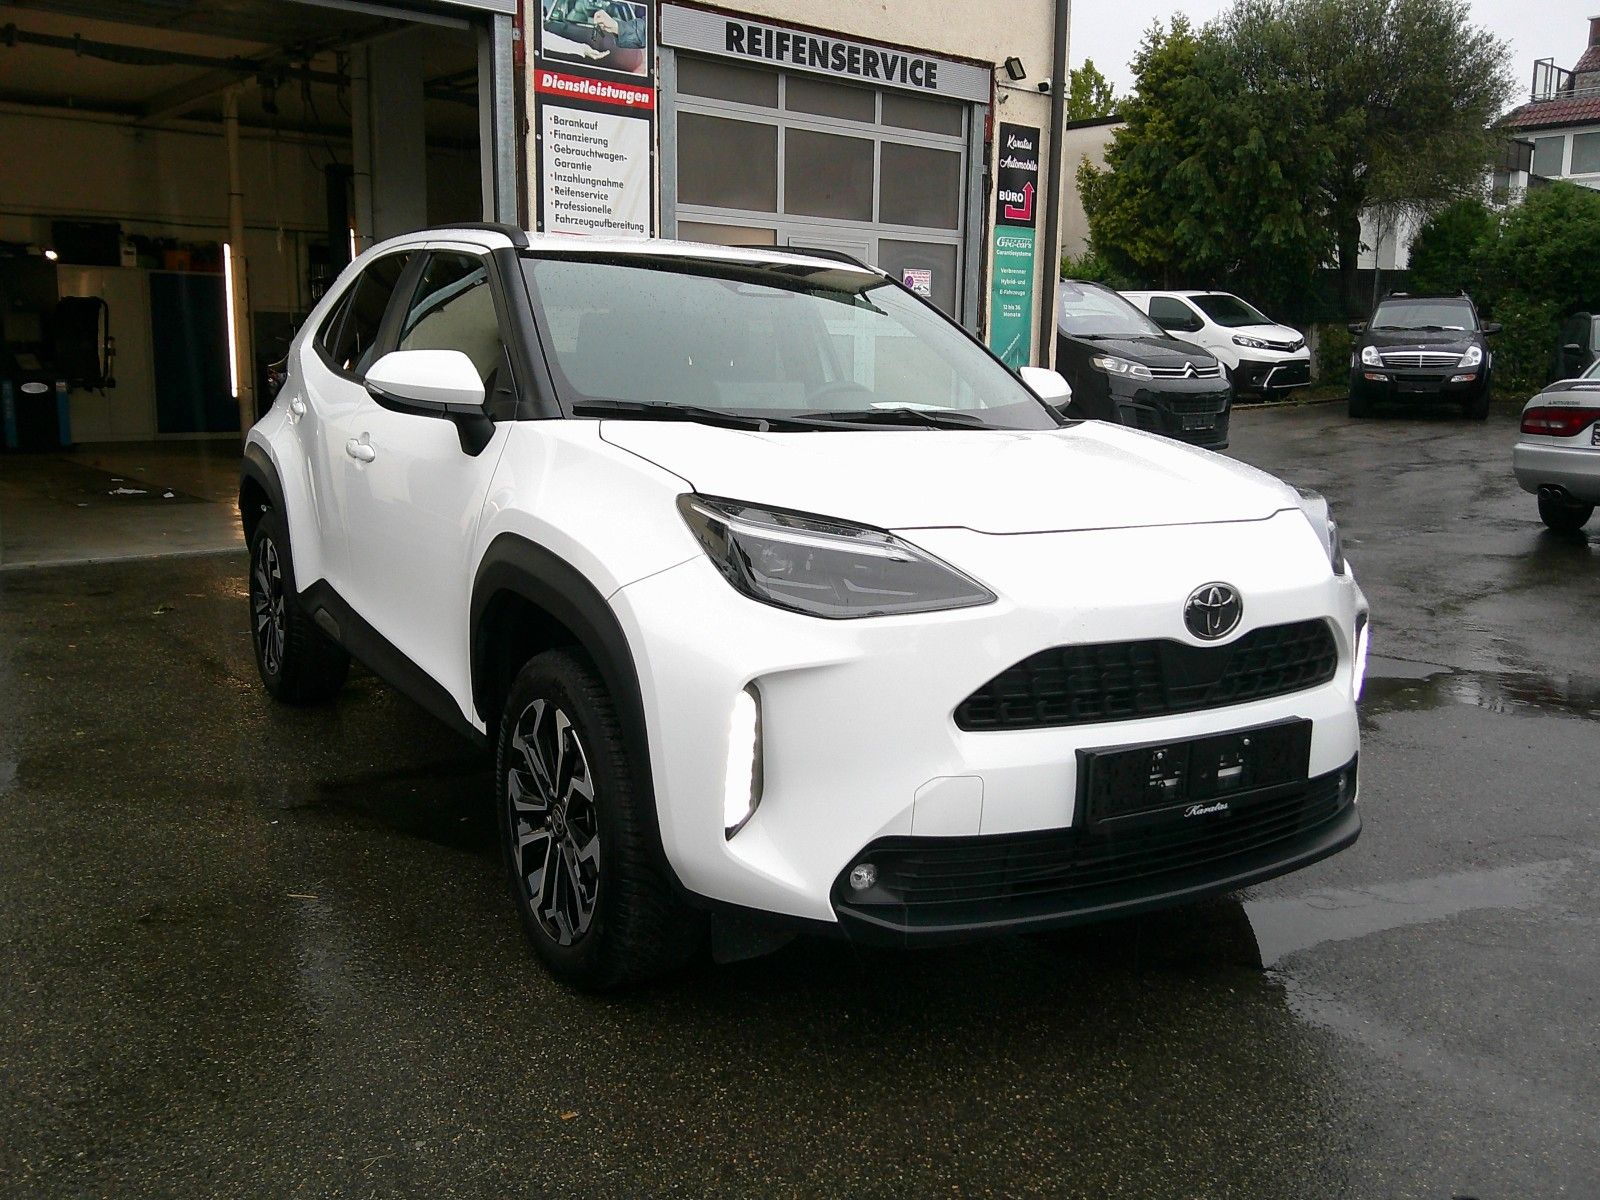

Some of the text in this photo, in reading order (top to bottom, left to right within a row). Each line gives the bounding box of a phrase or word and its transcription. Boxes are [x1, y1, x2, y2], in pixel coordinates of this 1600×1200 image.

[725, 21, 938, 89] REIFENSERVICE
[542, 74, 649, 104] Dienstleistungen
[554, 115, 598, 130] Barankauf
[554, 130, 608, 147] Finanzierung
[554, 144, 627, 162] Gebrauchtwagen-
[554, 157, 592, 172] Garantie
[554, 171, 625, 190] Inzahlungnahme
[554, 185, 609, 202] Reifenservice
[999, 189, 1024, 204] BÜRO
[554, 199, 613, 216] Professionelle
[555, 213, 645, 233] Fahrzeugaufbereitung
